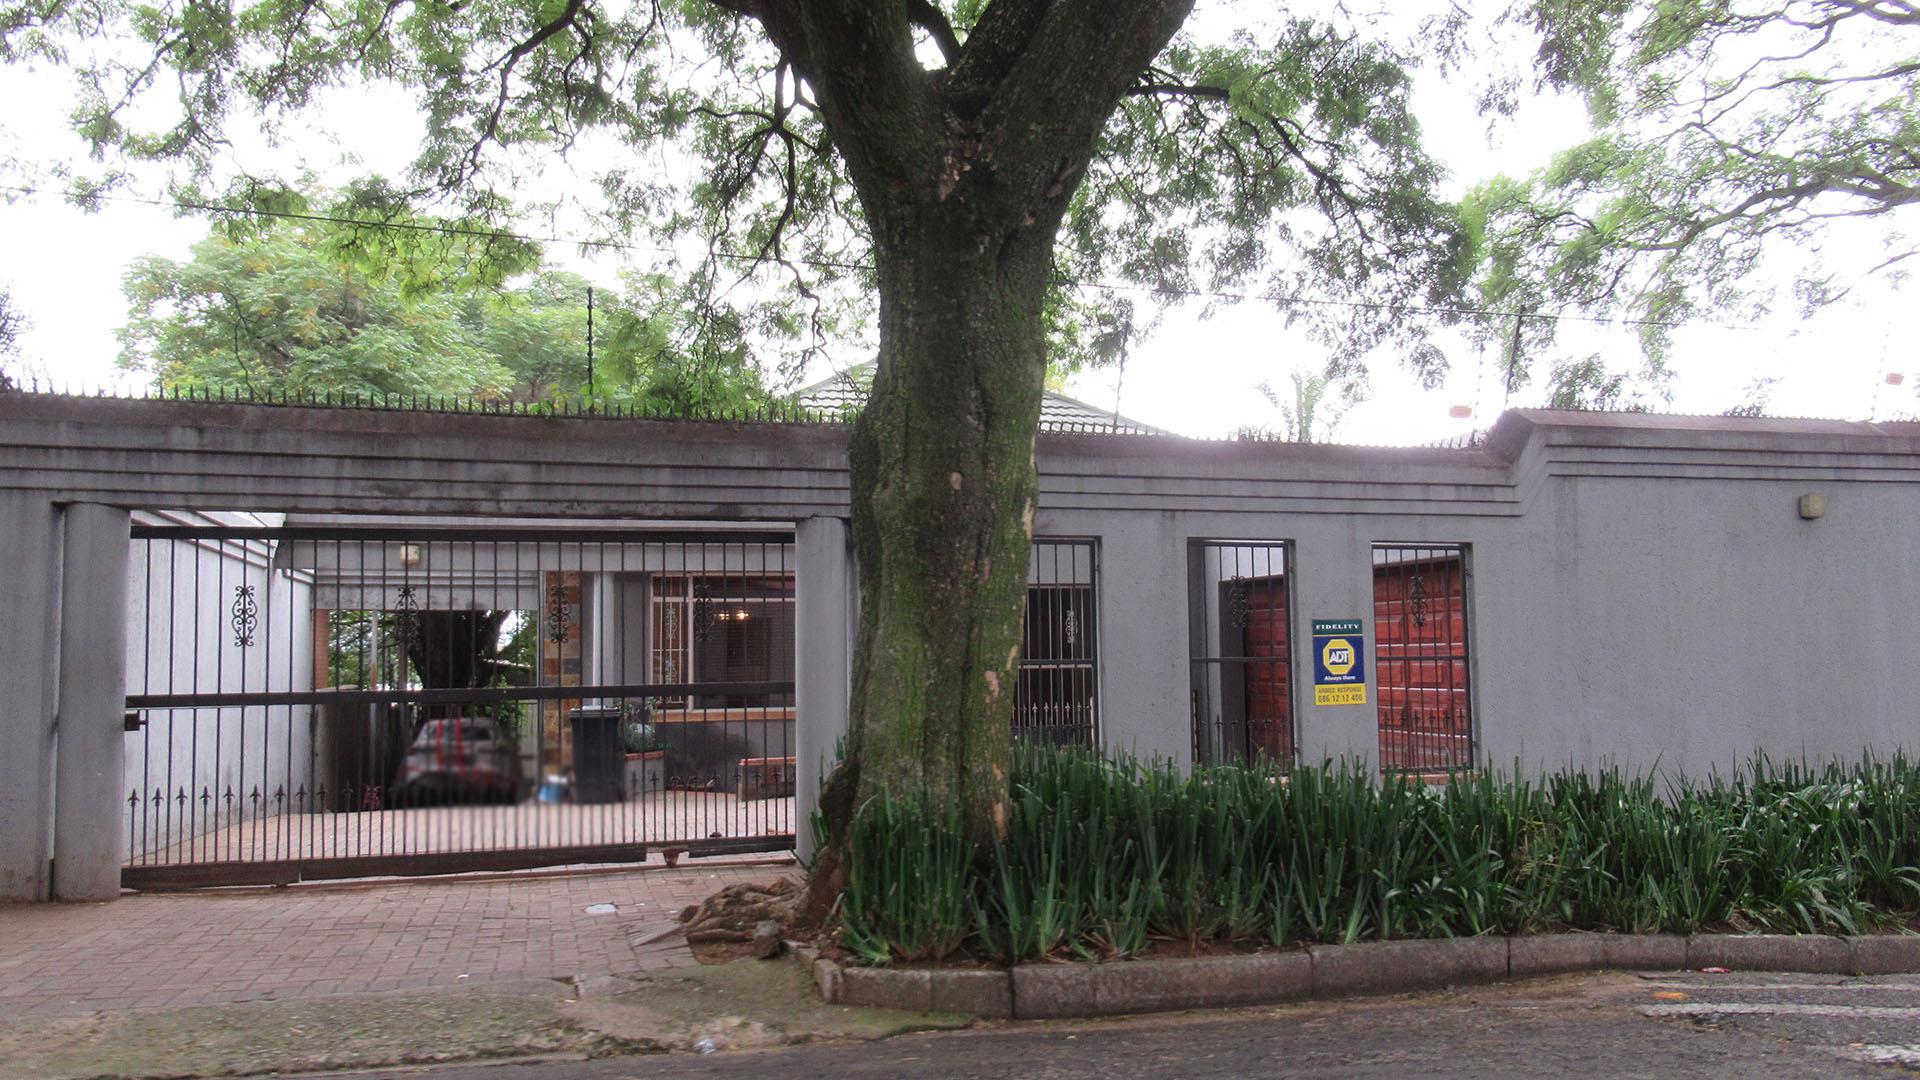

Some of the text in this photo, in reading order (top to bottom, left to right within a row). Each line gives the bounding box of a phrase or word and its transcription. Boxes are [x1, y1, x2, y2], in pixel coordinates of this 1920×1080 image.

[1329, 650, 1349, 663] ADT
[1318, 694, 1330, 702] 086
[1332, 694, 1340, 702] 12
[1343, 694, 1350, 702] 12
